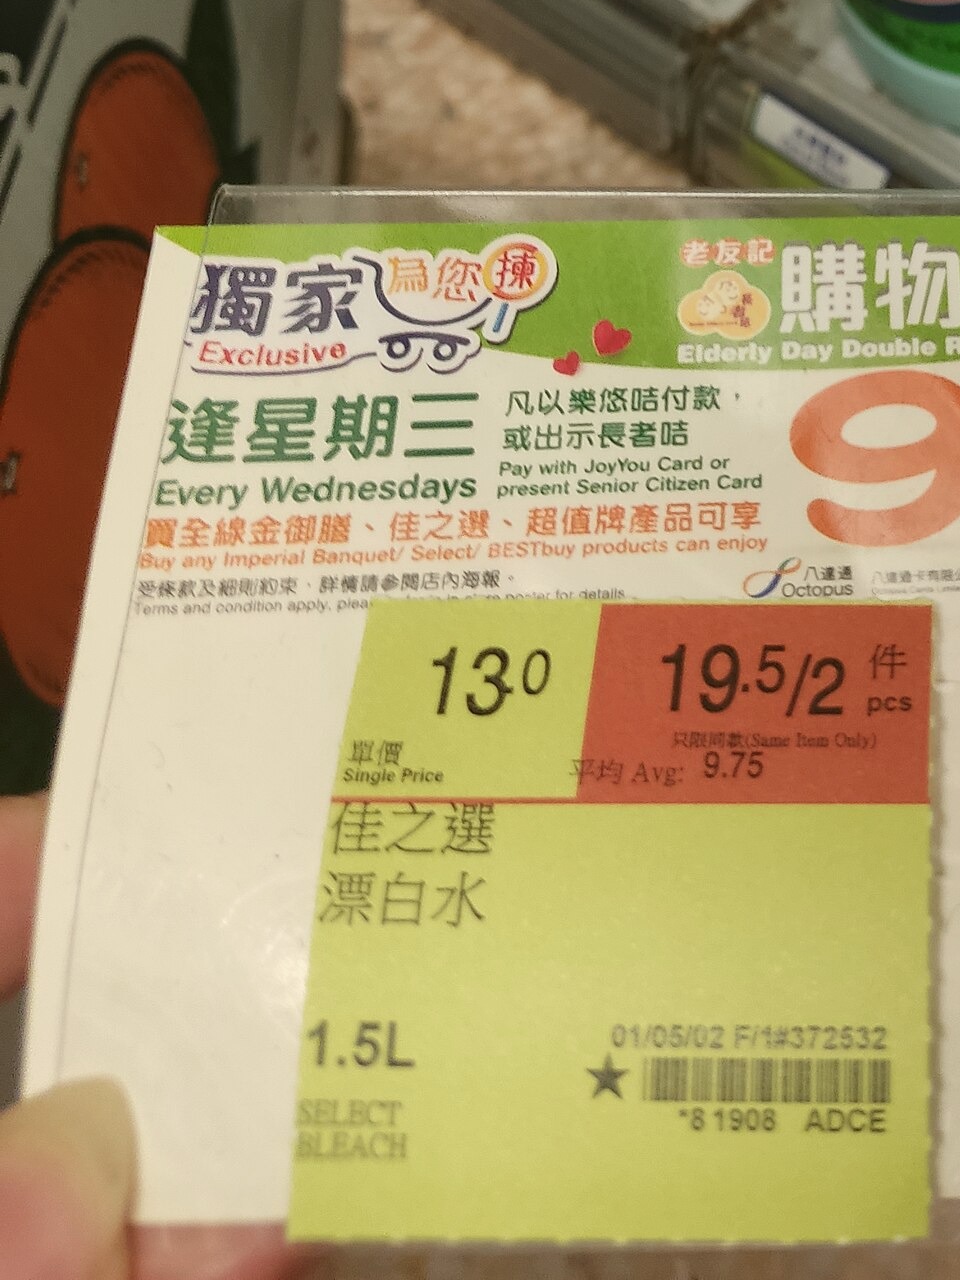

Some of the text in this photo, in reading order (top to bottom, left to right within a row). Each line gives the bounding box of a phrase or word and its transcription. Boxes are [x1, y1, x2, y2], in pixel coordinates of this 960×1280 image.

[682, 239, 774, 265] 老友記
[190, 263, 363, 337] 獨家
[199, 341, 348, 367] Exclusive
[677, 343, 772, 365] Elderly
[781, 340, 833, 363] Day
[842, 336, 937, 359] Double
[162, 392, 479, 464] 逢星期三
[502, 419, 690, 452] 或出示長者咭
[498, 455, 730, 480] Pay with JoyYou Card or
[154, 472, 478, 511] Every Wednesdays
[496, 473, 763, 500] present Senior Citizen Card
[139, 534, 768, 573] Buy any Imperial Banquet/ Select/ BESTbuy products can enjoy
[803, 566, 853, 582] 八達通
[781, 583, 854, 598] Octopus
[135, 600, 178, 617] Terms
[183, 600, 211, 615] and
[216, 598, 283, 615] condition
[337, 597, 375, 612] plea
[868, 644, 908, 680] 件
[866, 694, 913, 716] pcs
[348, 740, 404, 765] 單價
[343, 767, 445, 786] Single Price
[568, 750, 765, 787] 平均 Avg: 9.75
[332, 800, 496, 855] 佳之選
[318, 871, 487, 928] 漂白水
[307, 1019, 416, 1068] 1.5L
[611, 1023, 725, 1050] 01/05/02
[298, 1098, 404, 1127] SELECT
[803, 1108, 887, 1134] ADCE
[296, 1131, 408, 1160] BLEACH
